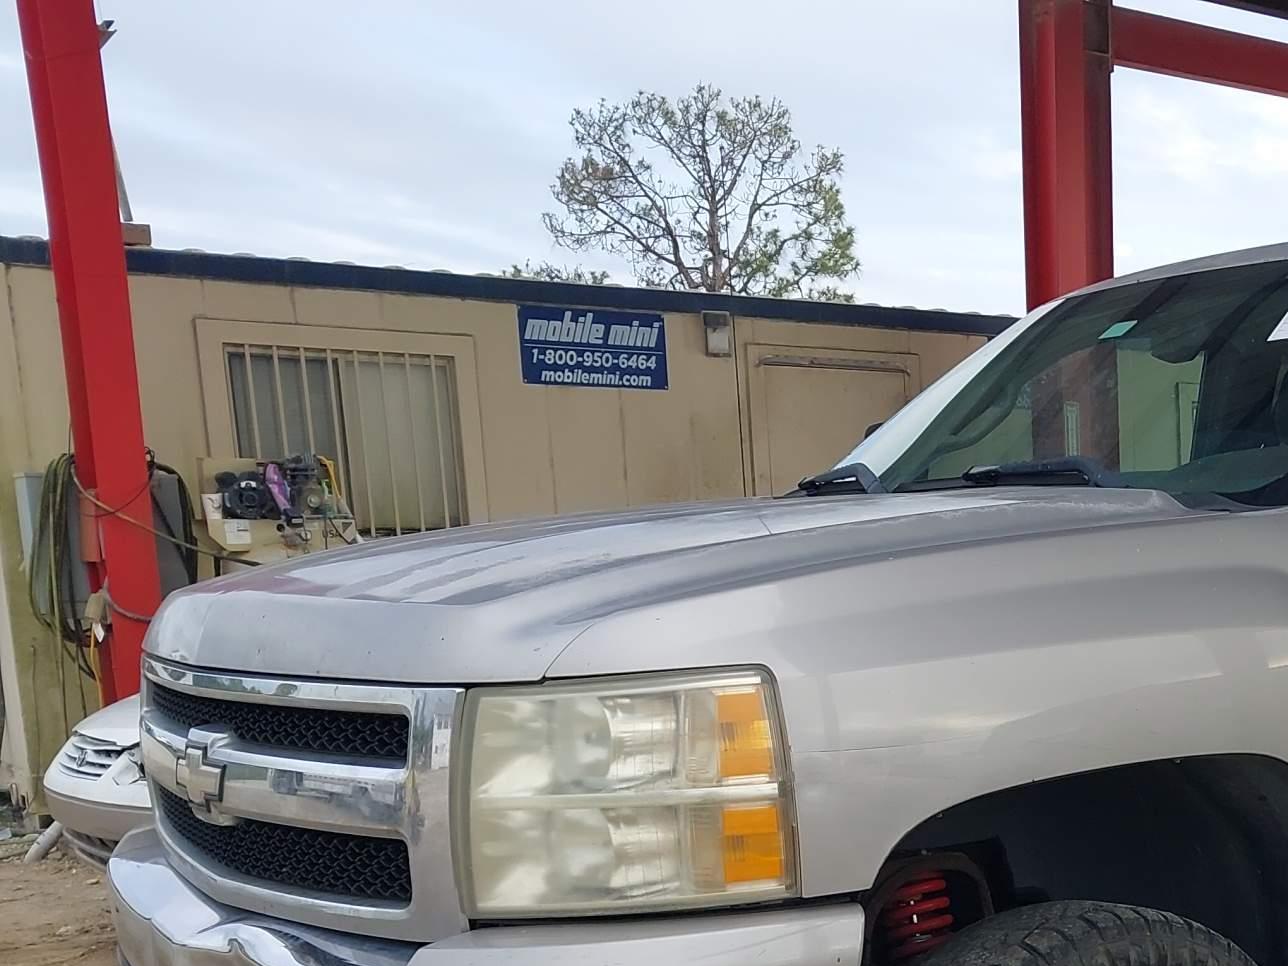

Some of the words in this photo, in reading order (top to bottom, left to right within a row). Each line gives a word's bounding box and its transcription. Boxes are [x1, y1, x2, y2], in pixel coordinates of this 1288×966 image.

[524, 311, 605, 344] mobile
[608, 321, 660, 348] mini
[531, 348, 657, 370] 1-800-950-6464
[541, 368, 652, 387] mobilemini.com
